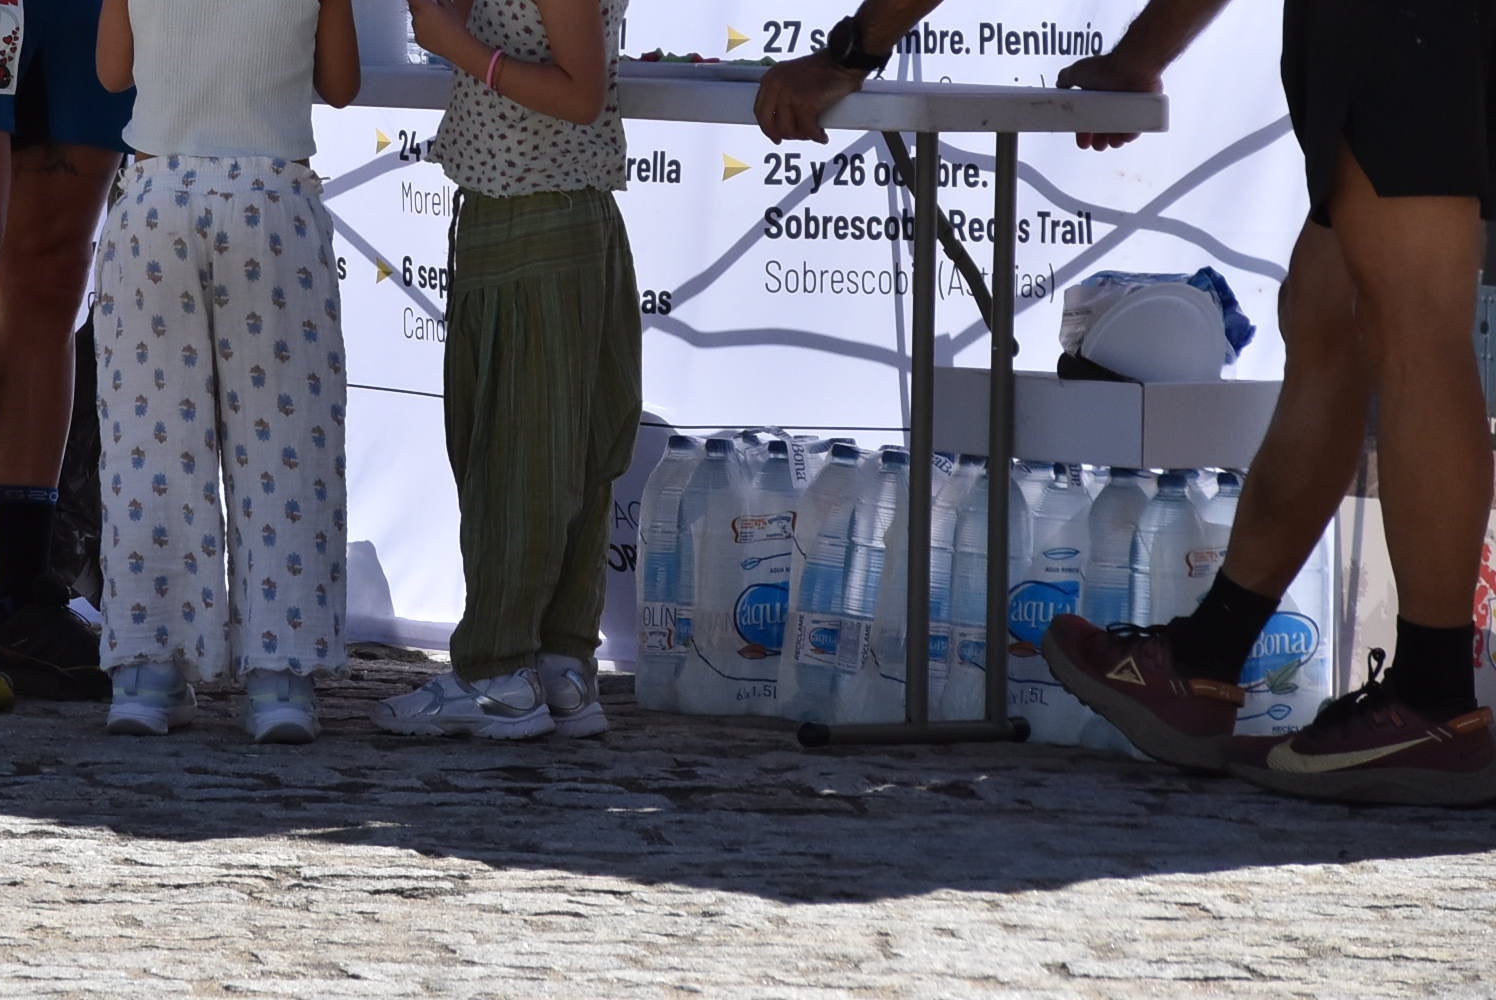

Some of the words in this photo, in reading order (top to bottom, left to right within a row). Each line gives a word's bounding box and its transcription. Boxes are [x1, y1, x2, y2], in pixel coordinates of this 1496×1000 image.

[763, 20, 802, 53] 27
[979, 22, 1103, 57] Plenilunio
[399, 130, 421, 162] 24
[626, 151, 681, 183] rella
[763, 153, 802, 186] 25
[810, 161, 825, 194] y
[833, 153, 866, 187] 26
[874, 155, 988, 188] ocbre.
[402, 181, 451, 216] Morell
[764, 207, 915, 241] Sobrescob
[1037, 211, 1093, 245] Trail
[402, 256, 414, 287] 6
[418, 265, 449, 298] sep
[765, 260, 915, 295] Sobrescobi
[641, 290, 672, 315] as
[403, 307, 447, 343] Cand
[741, 602, 789, 630] aqu
[1251, 631, 1310, 658] Bona
